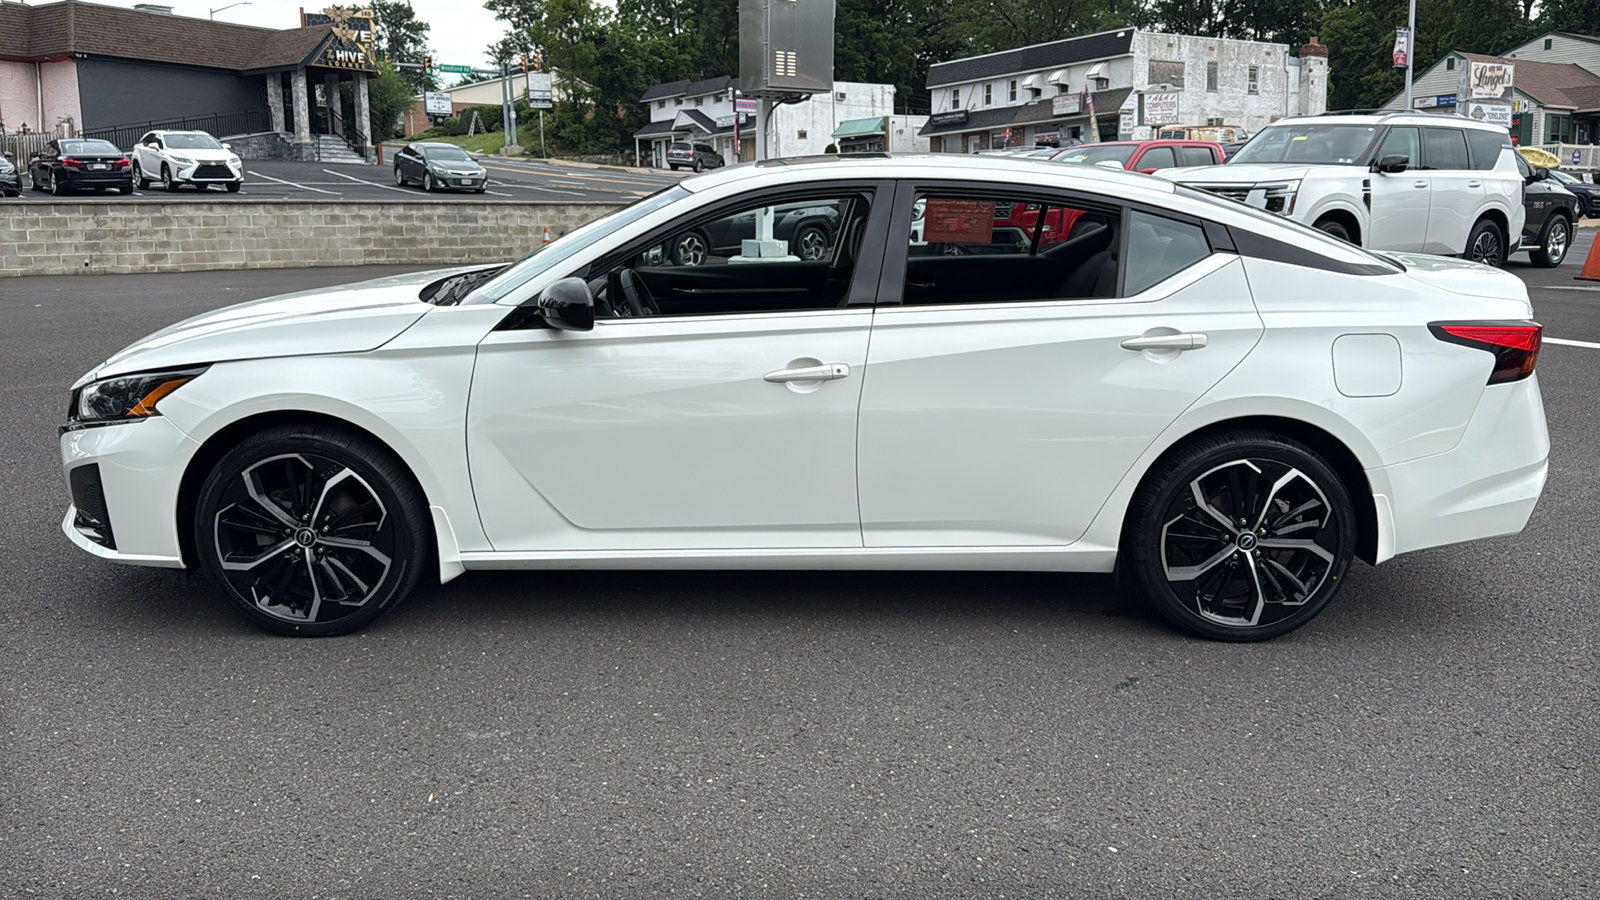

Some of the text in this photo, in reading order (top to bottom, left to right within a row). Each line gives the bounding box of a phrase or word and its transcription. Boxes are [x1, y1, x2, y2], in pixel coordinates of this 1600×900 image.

[335, 50, 366, 64] HIVE
[328, 60, 366, 70] LOUNGE
[441, 64, 463, 73] Woodland
[1472, 64, 1511, 92] Langel's
[1146, 101, 1176, 109] COMPUTERS
